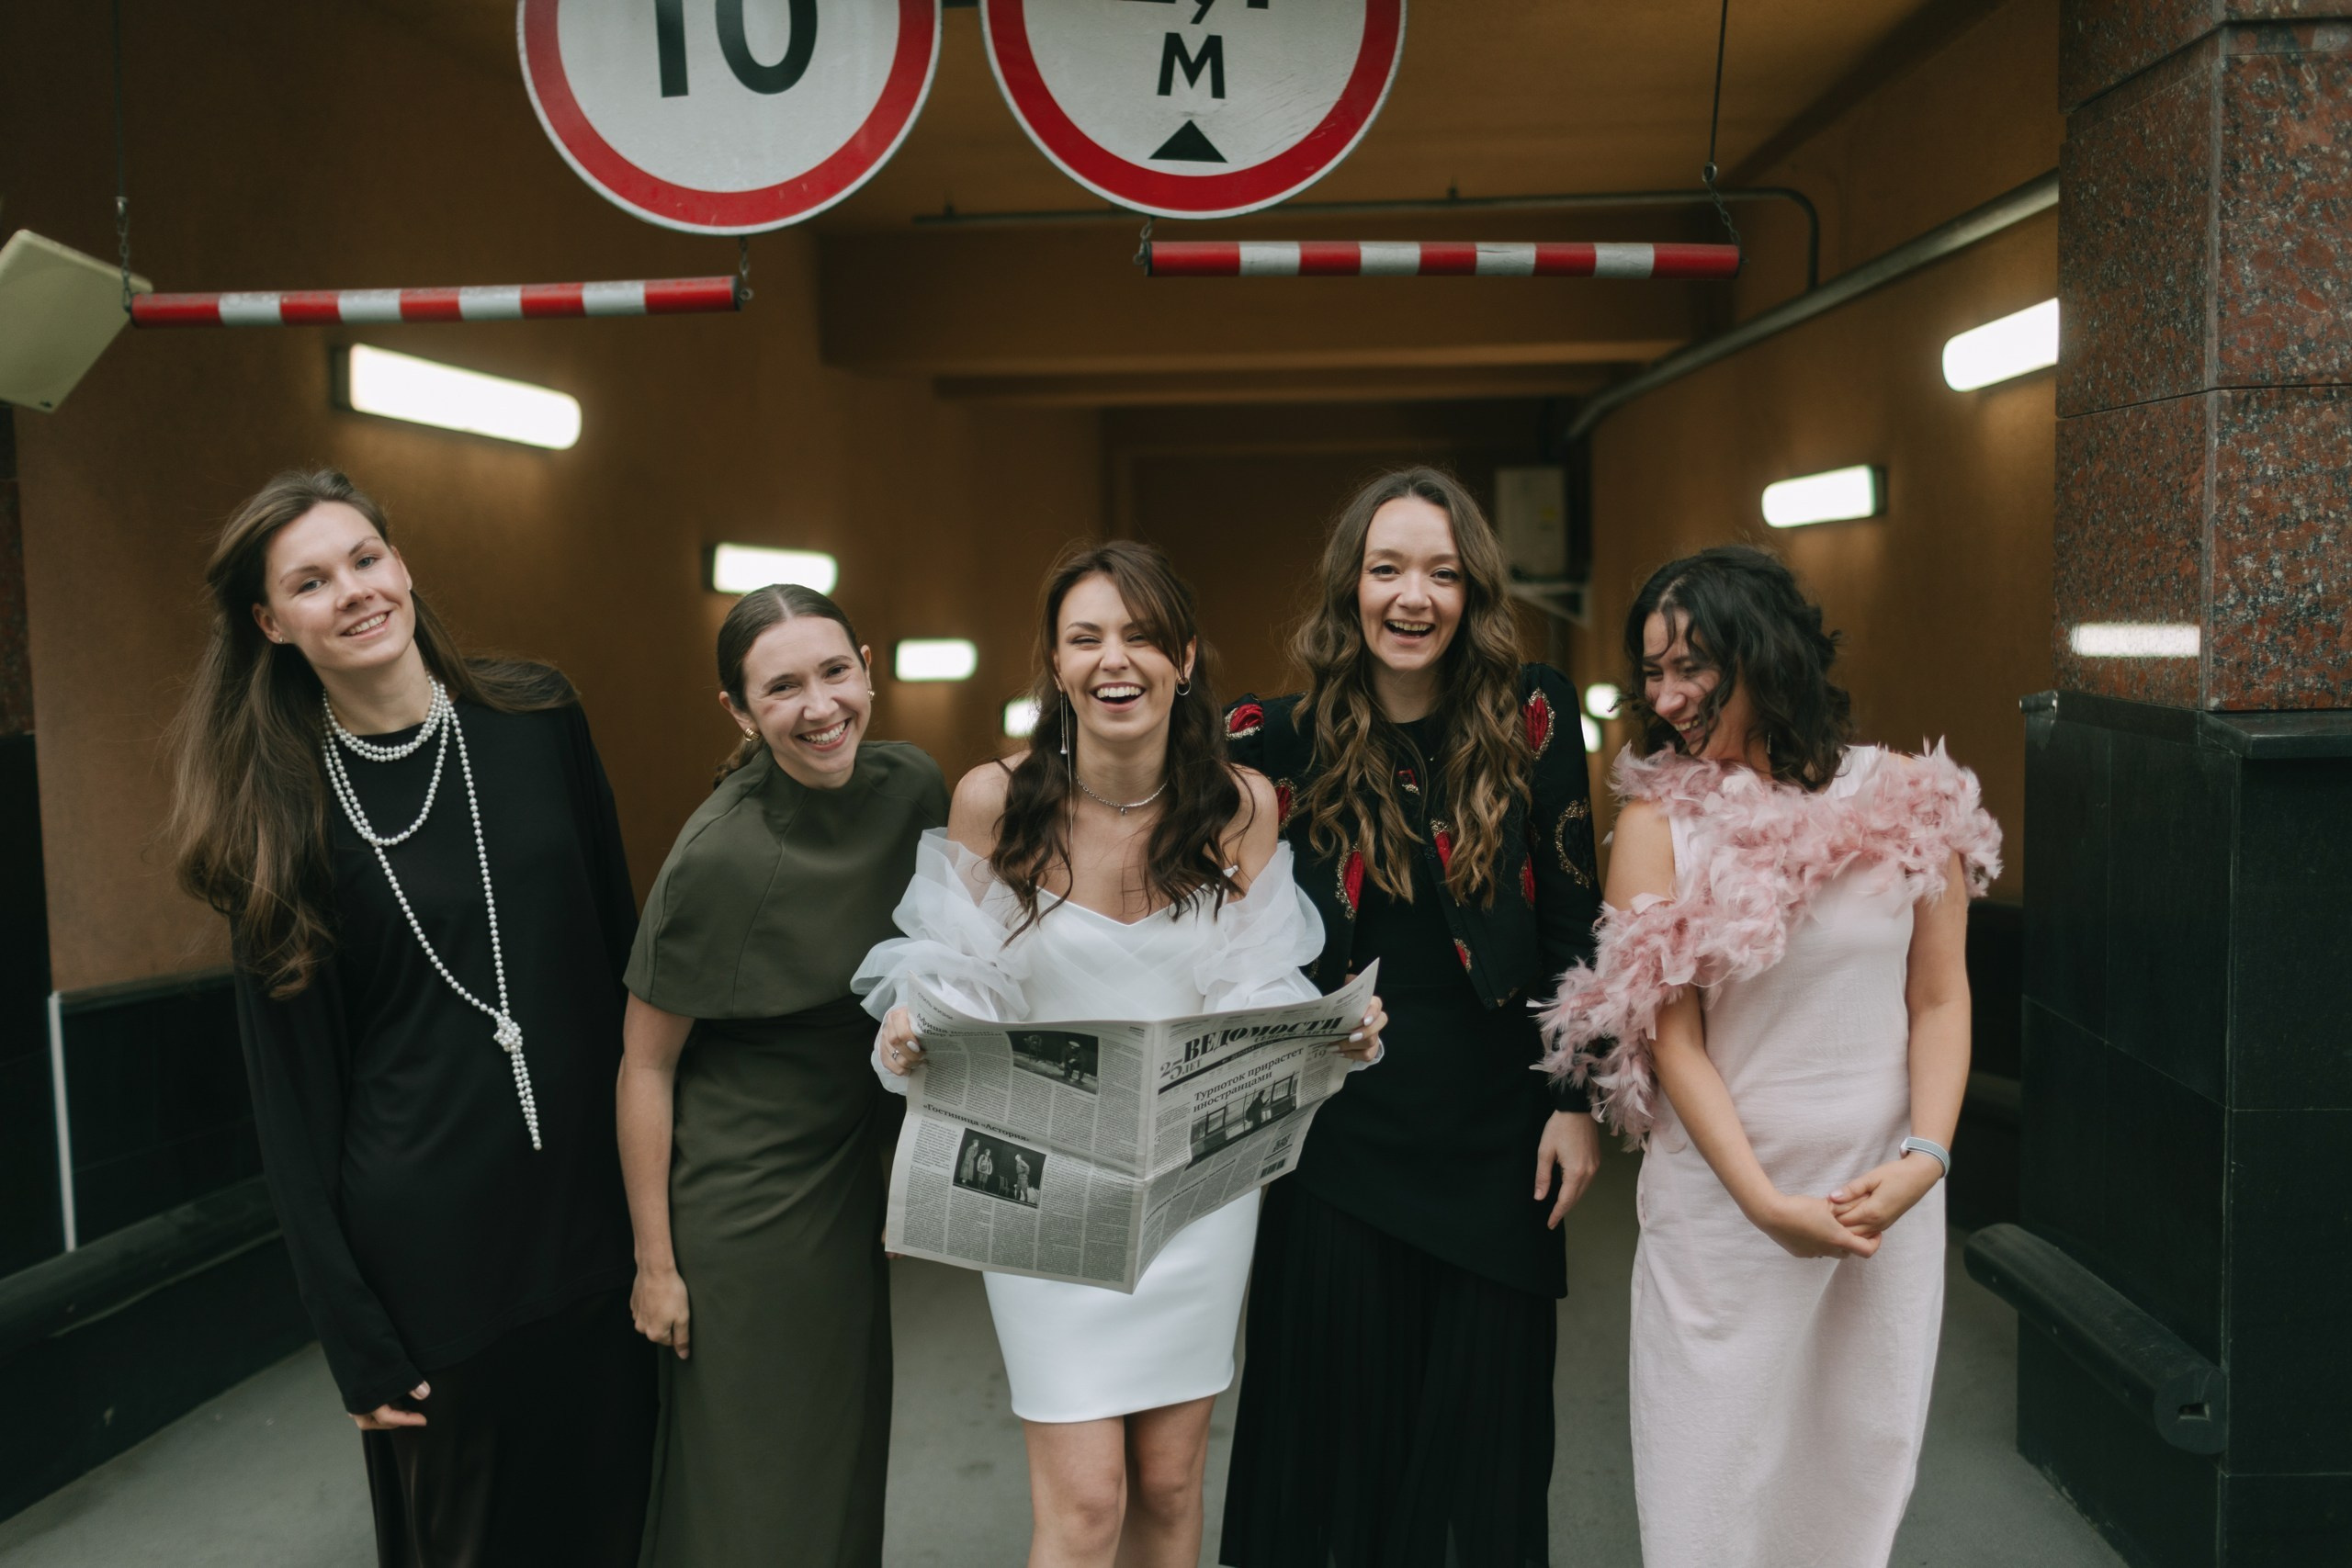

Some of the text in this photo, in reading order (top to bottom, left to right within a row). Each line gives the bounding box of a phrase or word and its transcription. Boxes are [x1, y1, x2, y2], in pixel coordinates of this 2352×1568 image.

[655, 0, 818, 97] 10
[1158, 32, 1226, 99] М
[1183, 1016, 1344, 1063] ВЕДОМОСТИ
[1160, 1057, 1183, 1080] 25
[1193, 1071, 1272, 1112] иностранцами
[1194, 1073, 1245, 1101] Турпоток
[1248, 1047, 1304, 1077] прирастет
